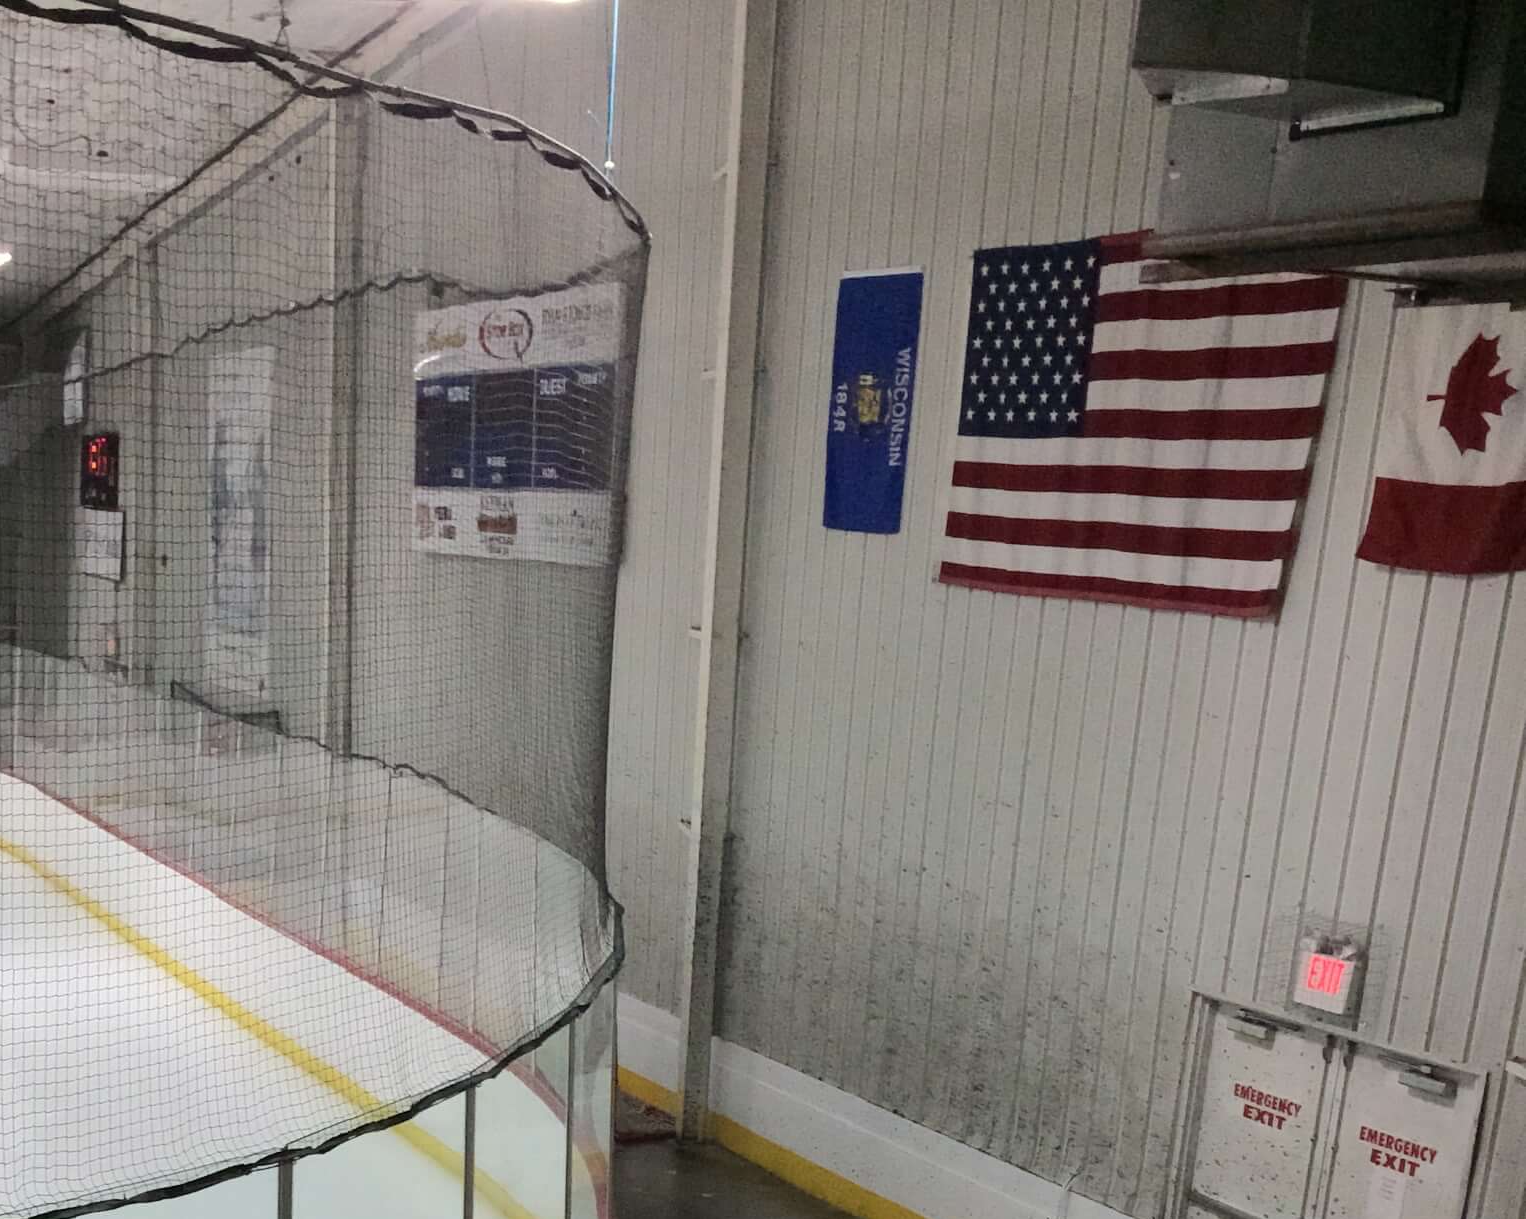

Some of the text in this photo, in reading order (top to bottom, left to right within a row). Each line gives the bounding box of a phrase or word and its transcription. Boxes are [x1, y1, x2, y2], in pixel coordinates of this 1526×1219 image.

[888, 347, 912, 467] WISCONSIN
[1307, 955, 1346, 996] EXIT
[1233, 1082, 1302, 1119] EMERGENCY
[1242, 1104, 1287, 1131] EXIT
[1358, 1126, 1438, 1165] EMERGENCY
[1369, 1148, 1421, 1178] EXIT
